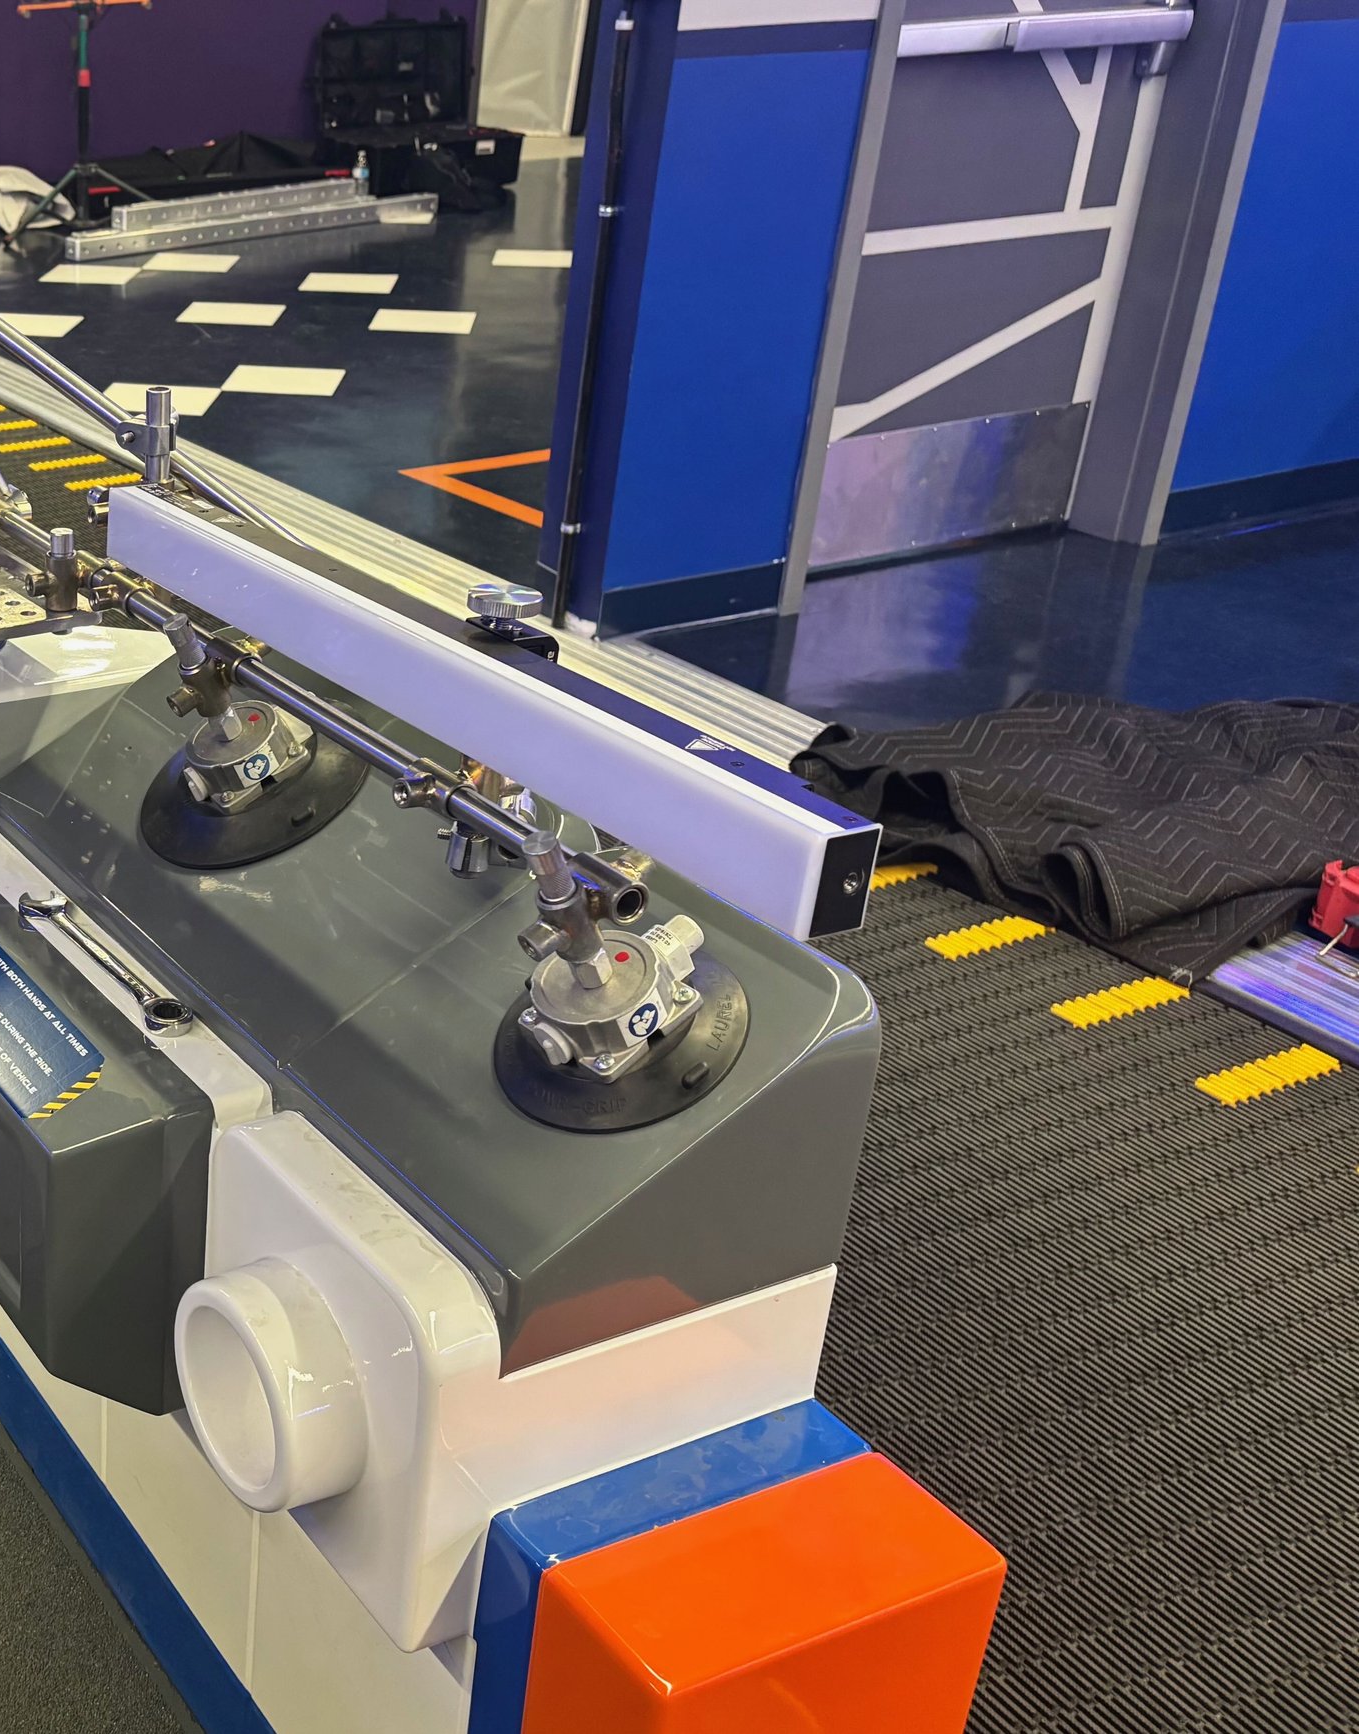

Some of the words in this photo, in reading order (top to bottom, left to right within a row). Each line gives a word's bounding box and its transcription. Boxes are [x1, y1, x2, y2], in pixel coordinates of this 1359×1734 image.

[6, 970, 26, 989] BOTH
[22, 986, 47, 1011] HANDS
[43, 1011, 55, 1020] AT
[52, 1020, 67, 1035] ALL
[66, 1033, 88, 1056] TIMES
[706, 994, 732, 1051] LAUREL
[0, 1052, 12, 1063] OF
[10, 1062, 38, 1095] VEHICLE
[1, 1018, 25, 1044] DURING
[23, 1042, 38, 1058] THE
[34, 1057, 53, 1076] RIDE.
